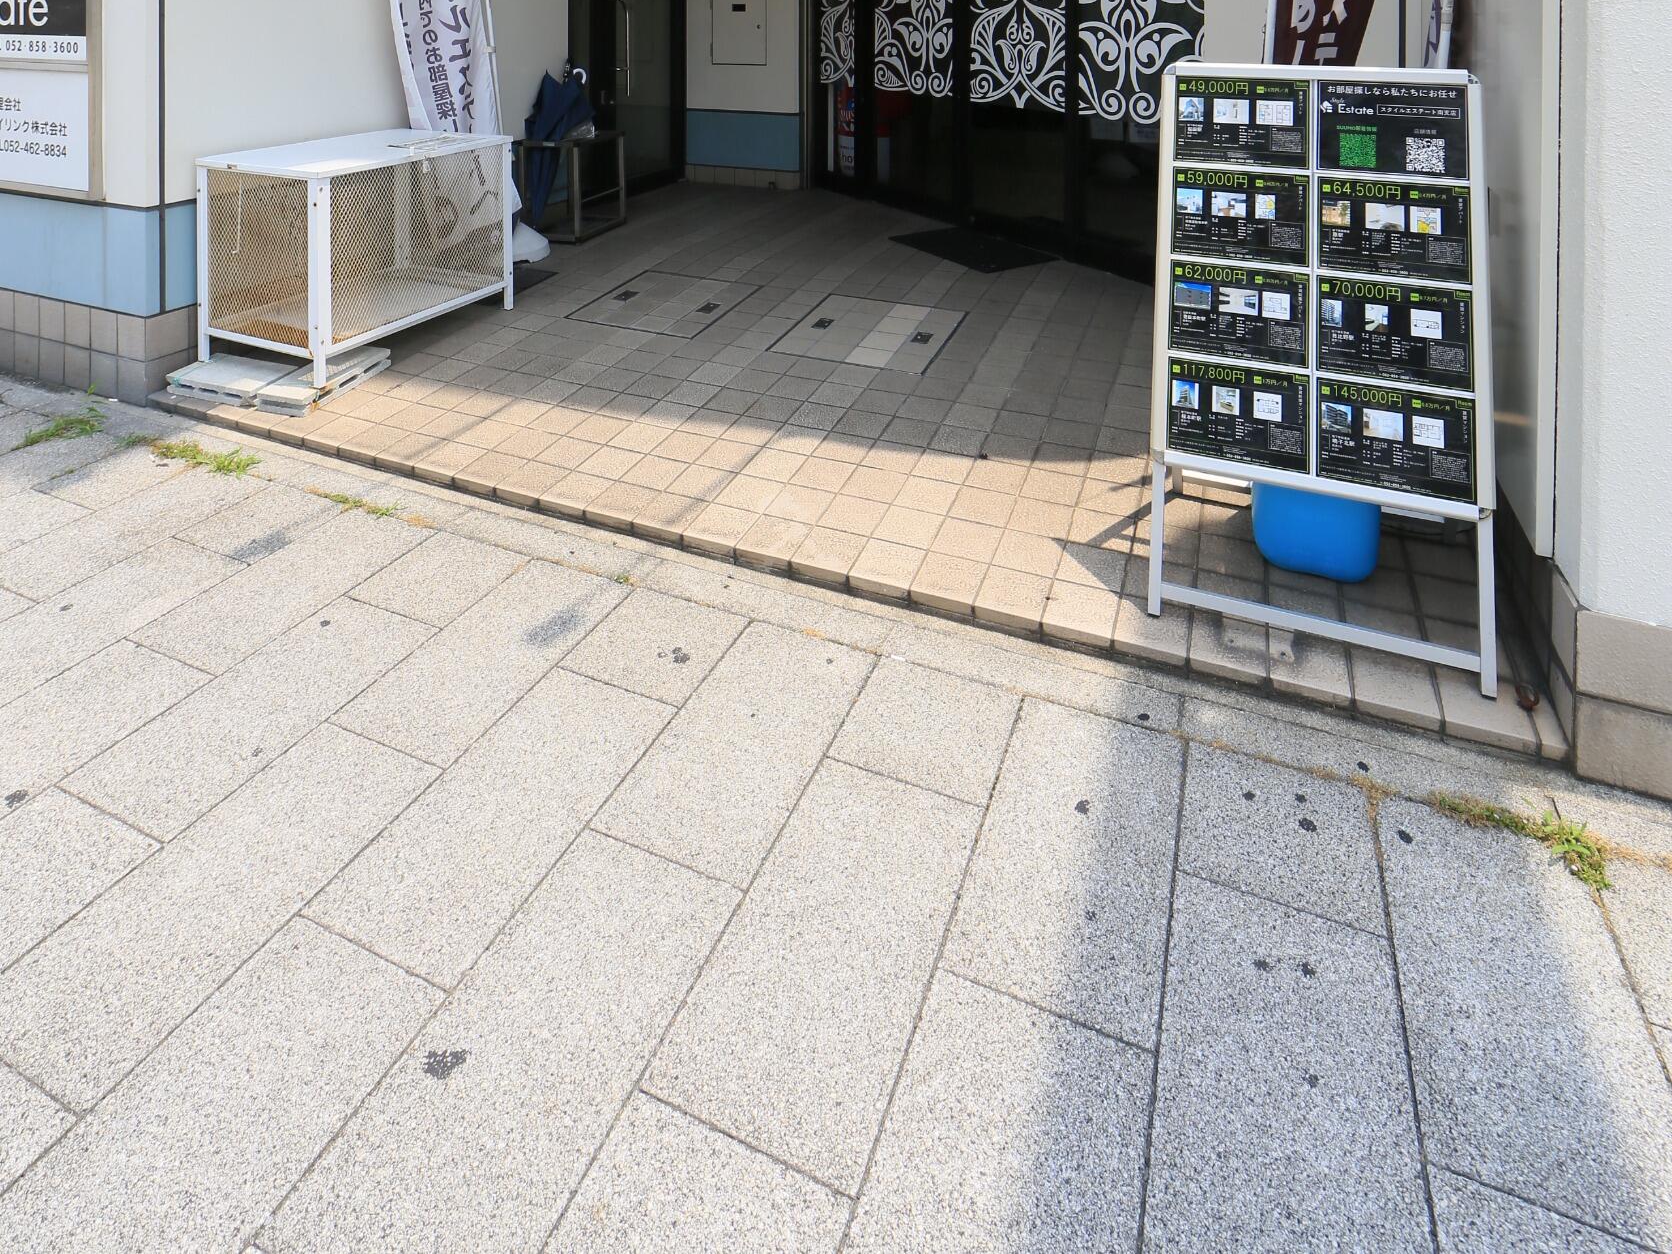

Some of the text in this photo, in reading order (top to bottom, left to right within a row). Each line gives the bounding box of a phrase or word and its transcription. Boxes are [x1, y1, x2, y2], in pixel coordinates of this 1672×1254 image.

[1189, 80, 1249, 95] 49,000円
[1327, 85, 1457, 99] お部屋探しなら私たちにお任せ
[1338, 104, 1374, 115] Estate
[1187, 171, 1248, 188] 59,000円
[1333, 182, 1401, 200] 64,500円
[1185, 265, 1247, 284] 62,000円
[1333, 281, 1401, 301] 70,000円
[1183, 364, 1245, 383] 117,800円
[1333, 385, 1402, 407] 145,000円
